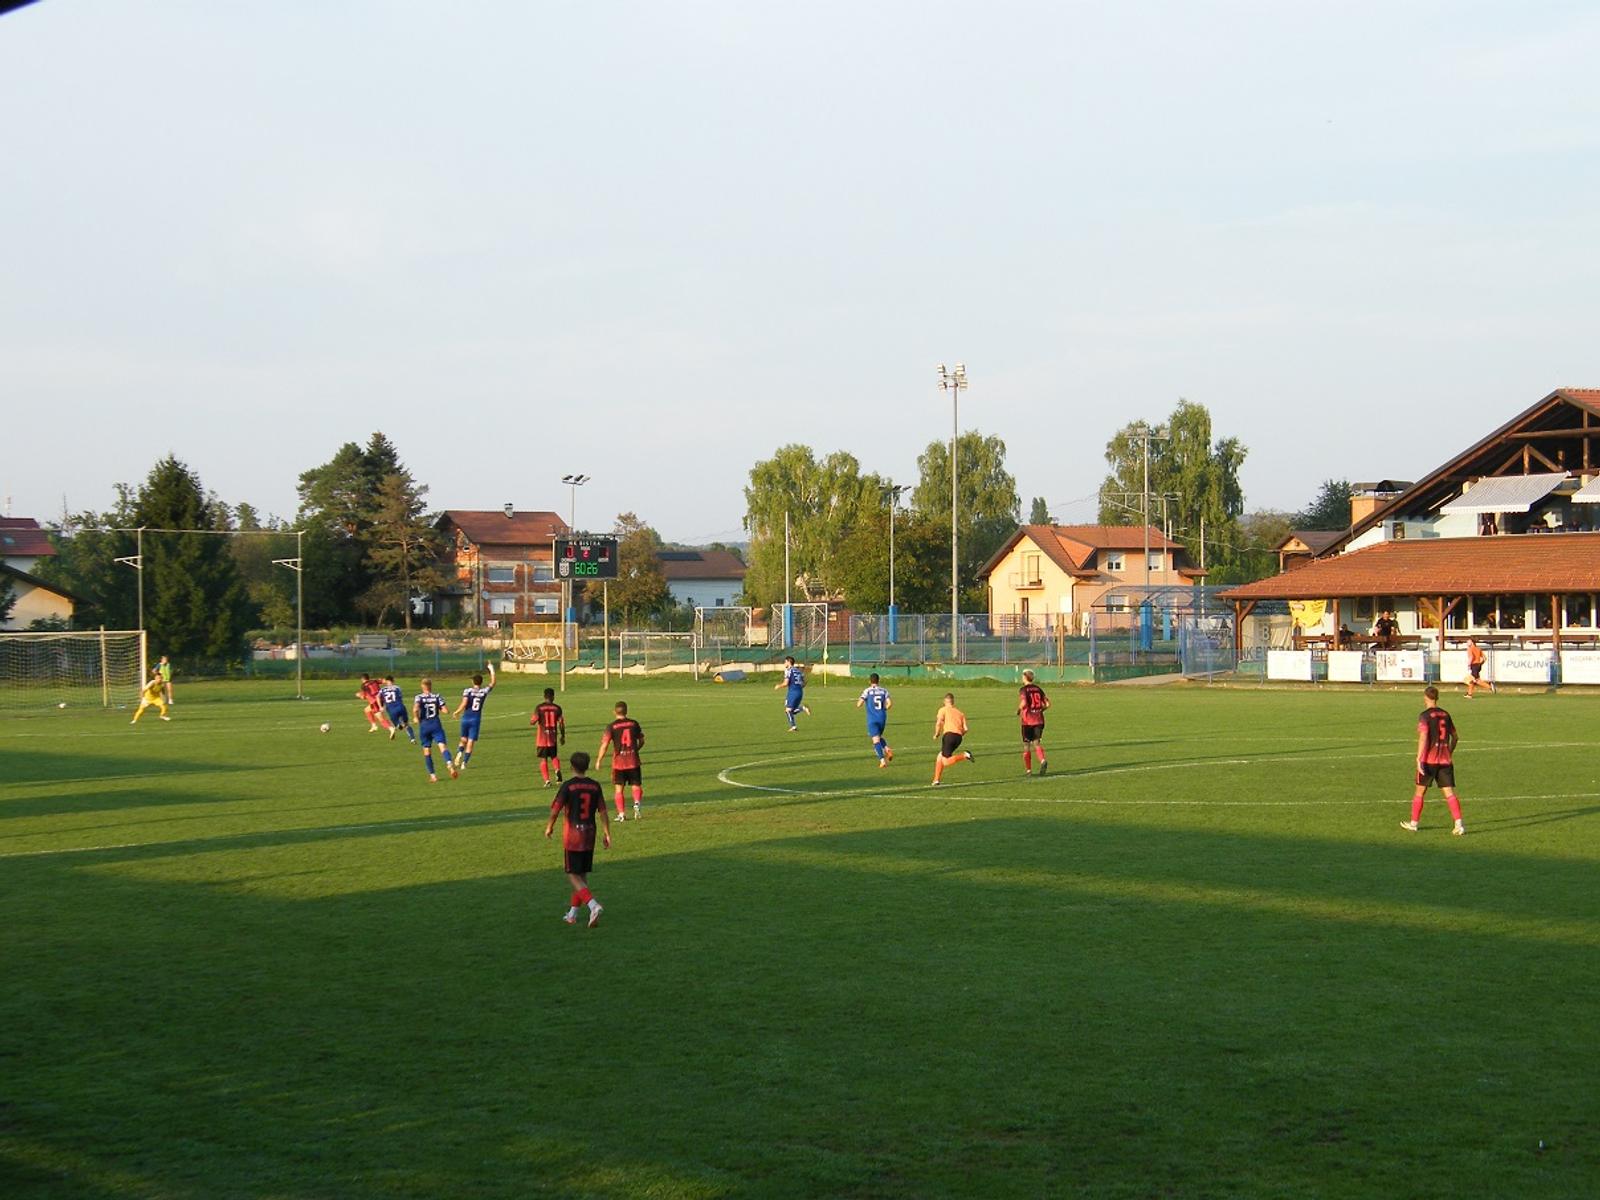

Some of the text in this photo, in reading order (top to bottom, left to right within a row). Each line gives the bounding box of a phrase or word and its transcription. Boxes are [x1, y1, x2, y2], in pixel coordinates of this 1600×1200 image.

[384, 692, 396, 703] 21
[472, 697, 481, 711] 6
[873, 695, 883, 710] 5
[1030, 692, 1041, 708] 19
[424, 703, 437, 719] 13
[544, 711, 555, 728] 11
[621, 728, 631, 747] 4
[1439, 719, 1447, 740] 5
[580, 793, 591, 820] 3
